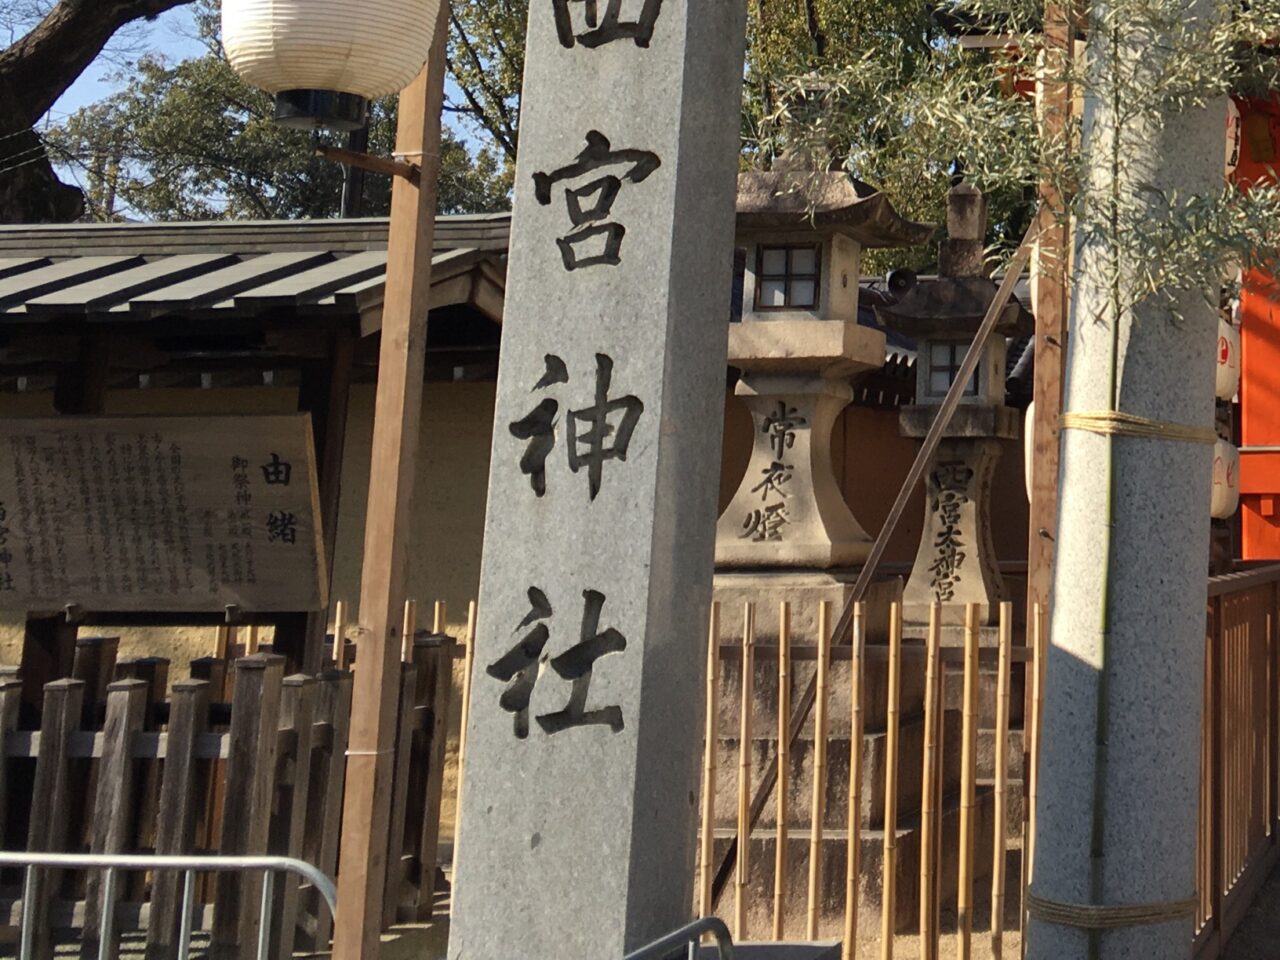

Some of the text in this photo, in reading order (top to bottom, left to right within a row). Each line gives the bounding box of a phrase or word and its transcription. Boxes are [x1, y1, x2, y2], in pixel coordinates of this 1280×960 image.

[260, 452, 297, 545] 由緒
[738, 400, 806, 542] 常夜燈
[928, 460, 974, 602] 西宮大神宮
